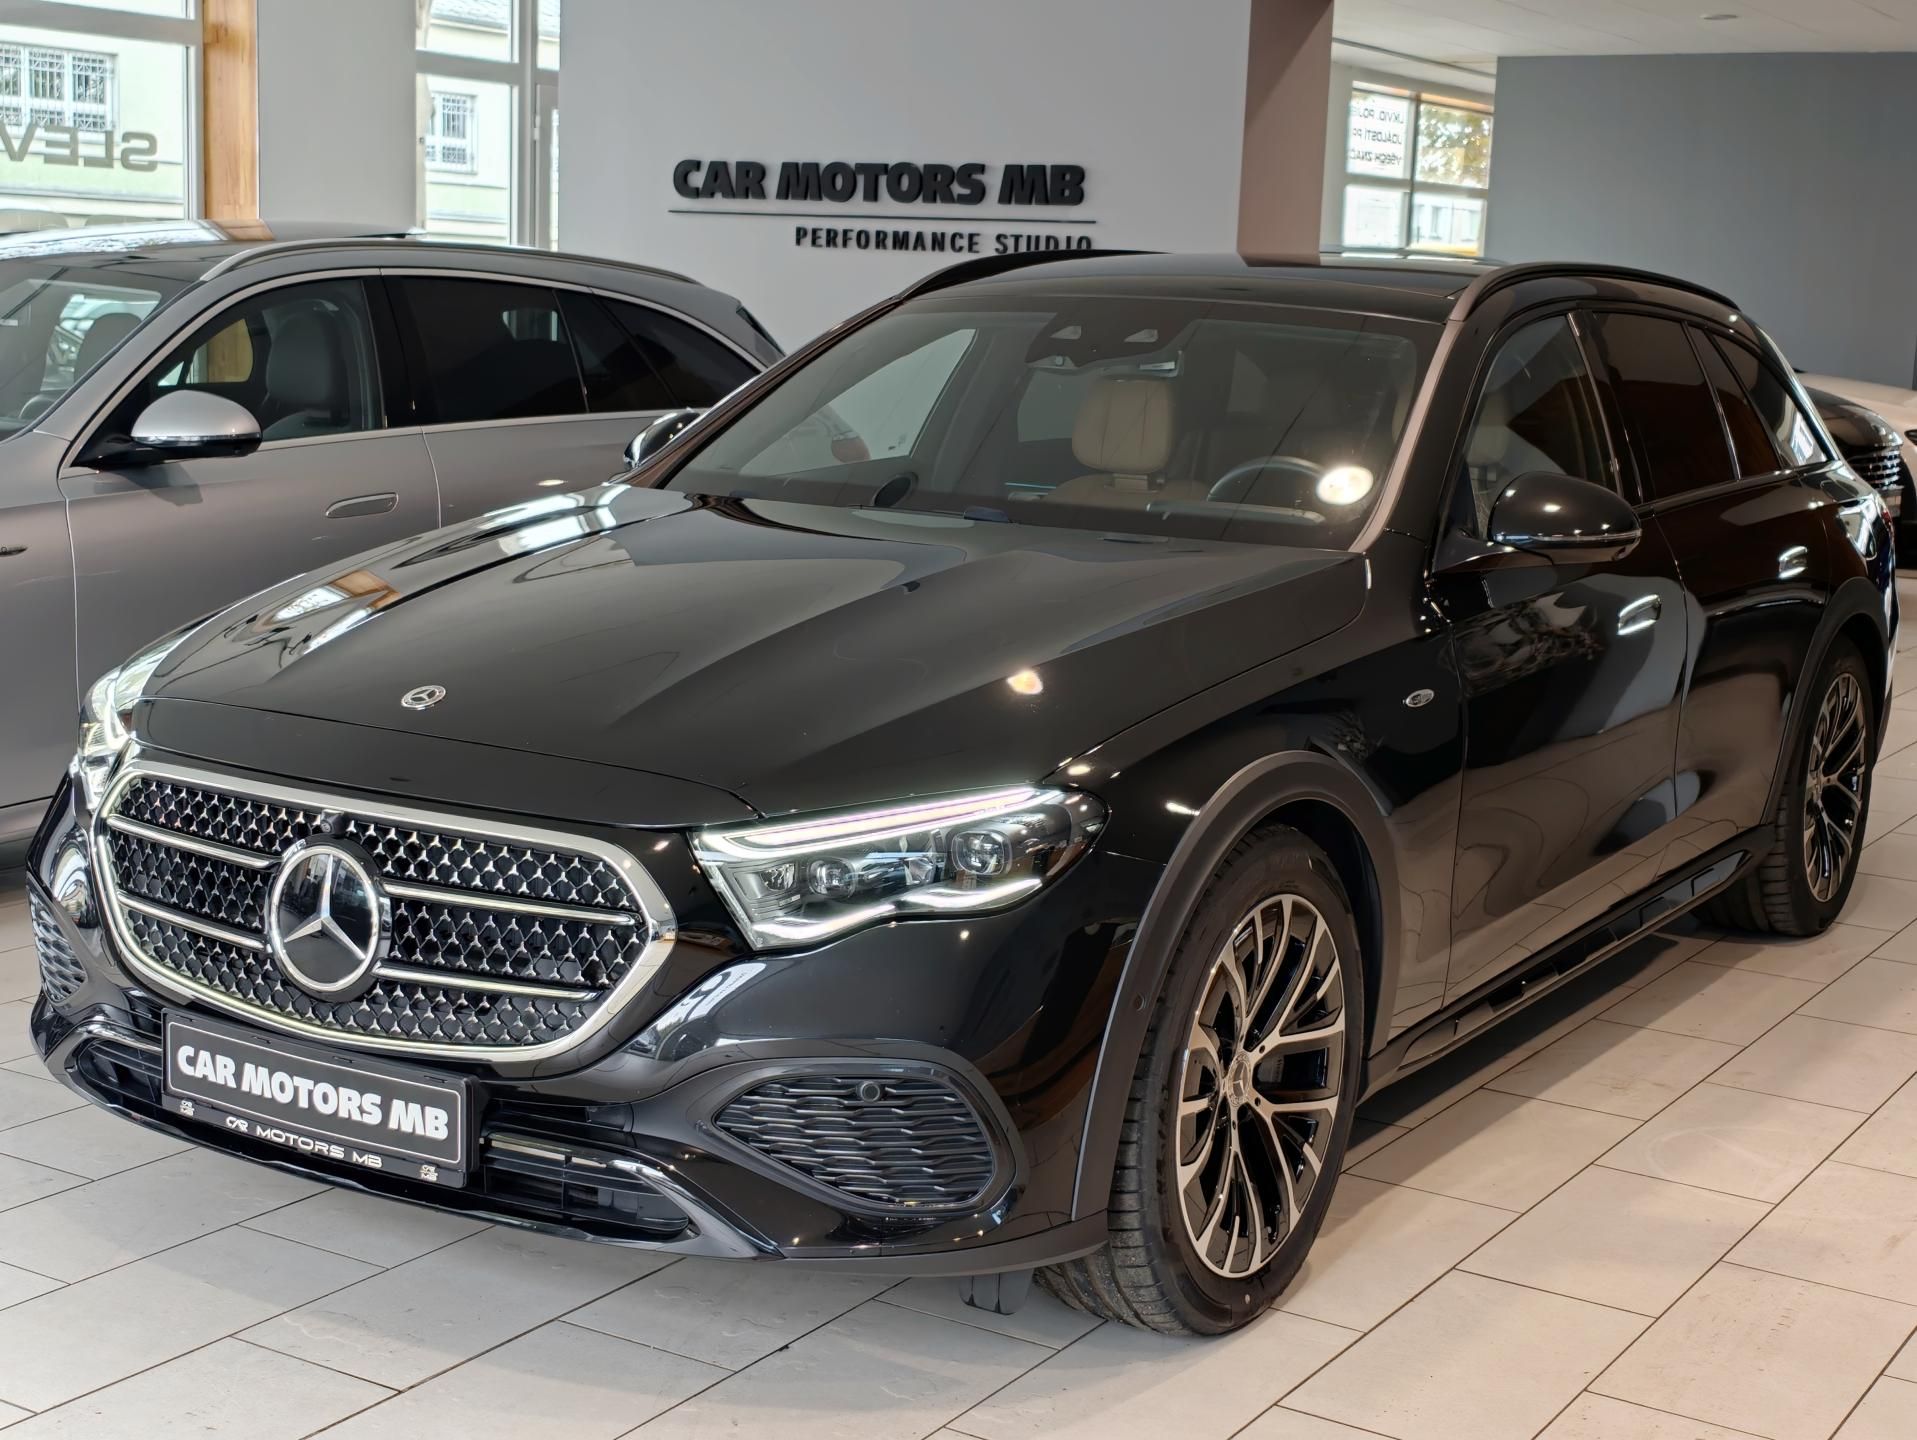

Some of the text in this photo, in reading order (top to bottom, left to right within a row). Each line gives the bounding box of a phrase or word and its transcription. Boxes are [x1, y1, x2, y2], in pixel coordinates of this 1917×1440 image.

[673, 158, 1086, 207] CAR MOTORS MB
[795, 226, 1093, 255] PERFORMANCE STUDIO
[177, 1045, 450, 1142] CAR MOTORS MB
[256, 1125, 345, 1159] MOTORS
[353, 1150, 383, 1169] MB
